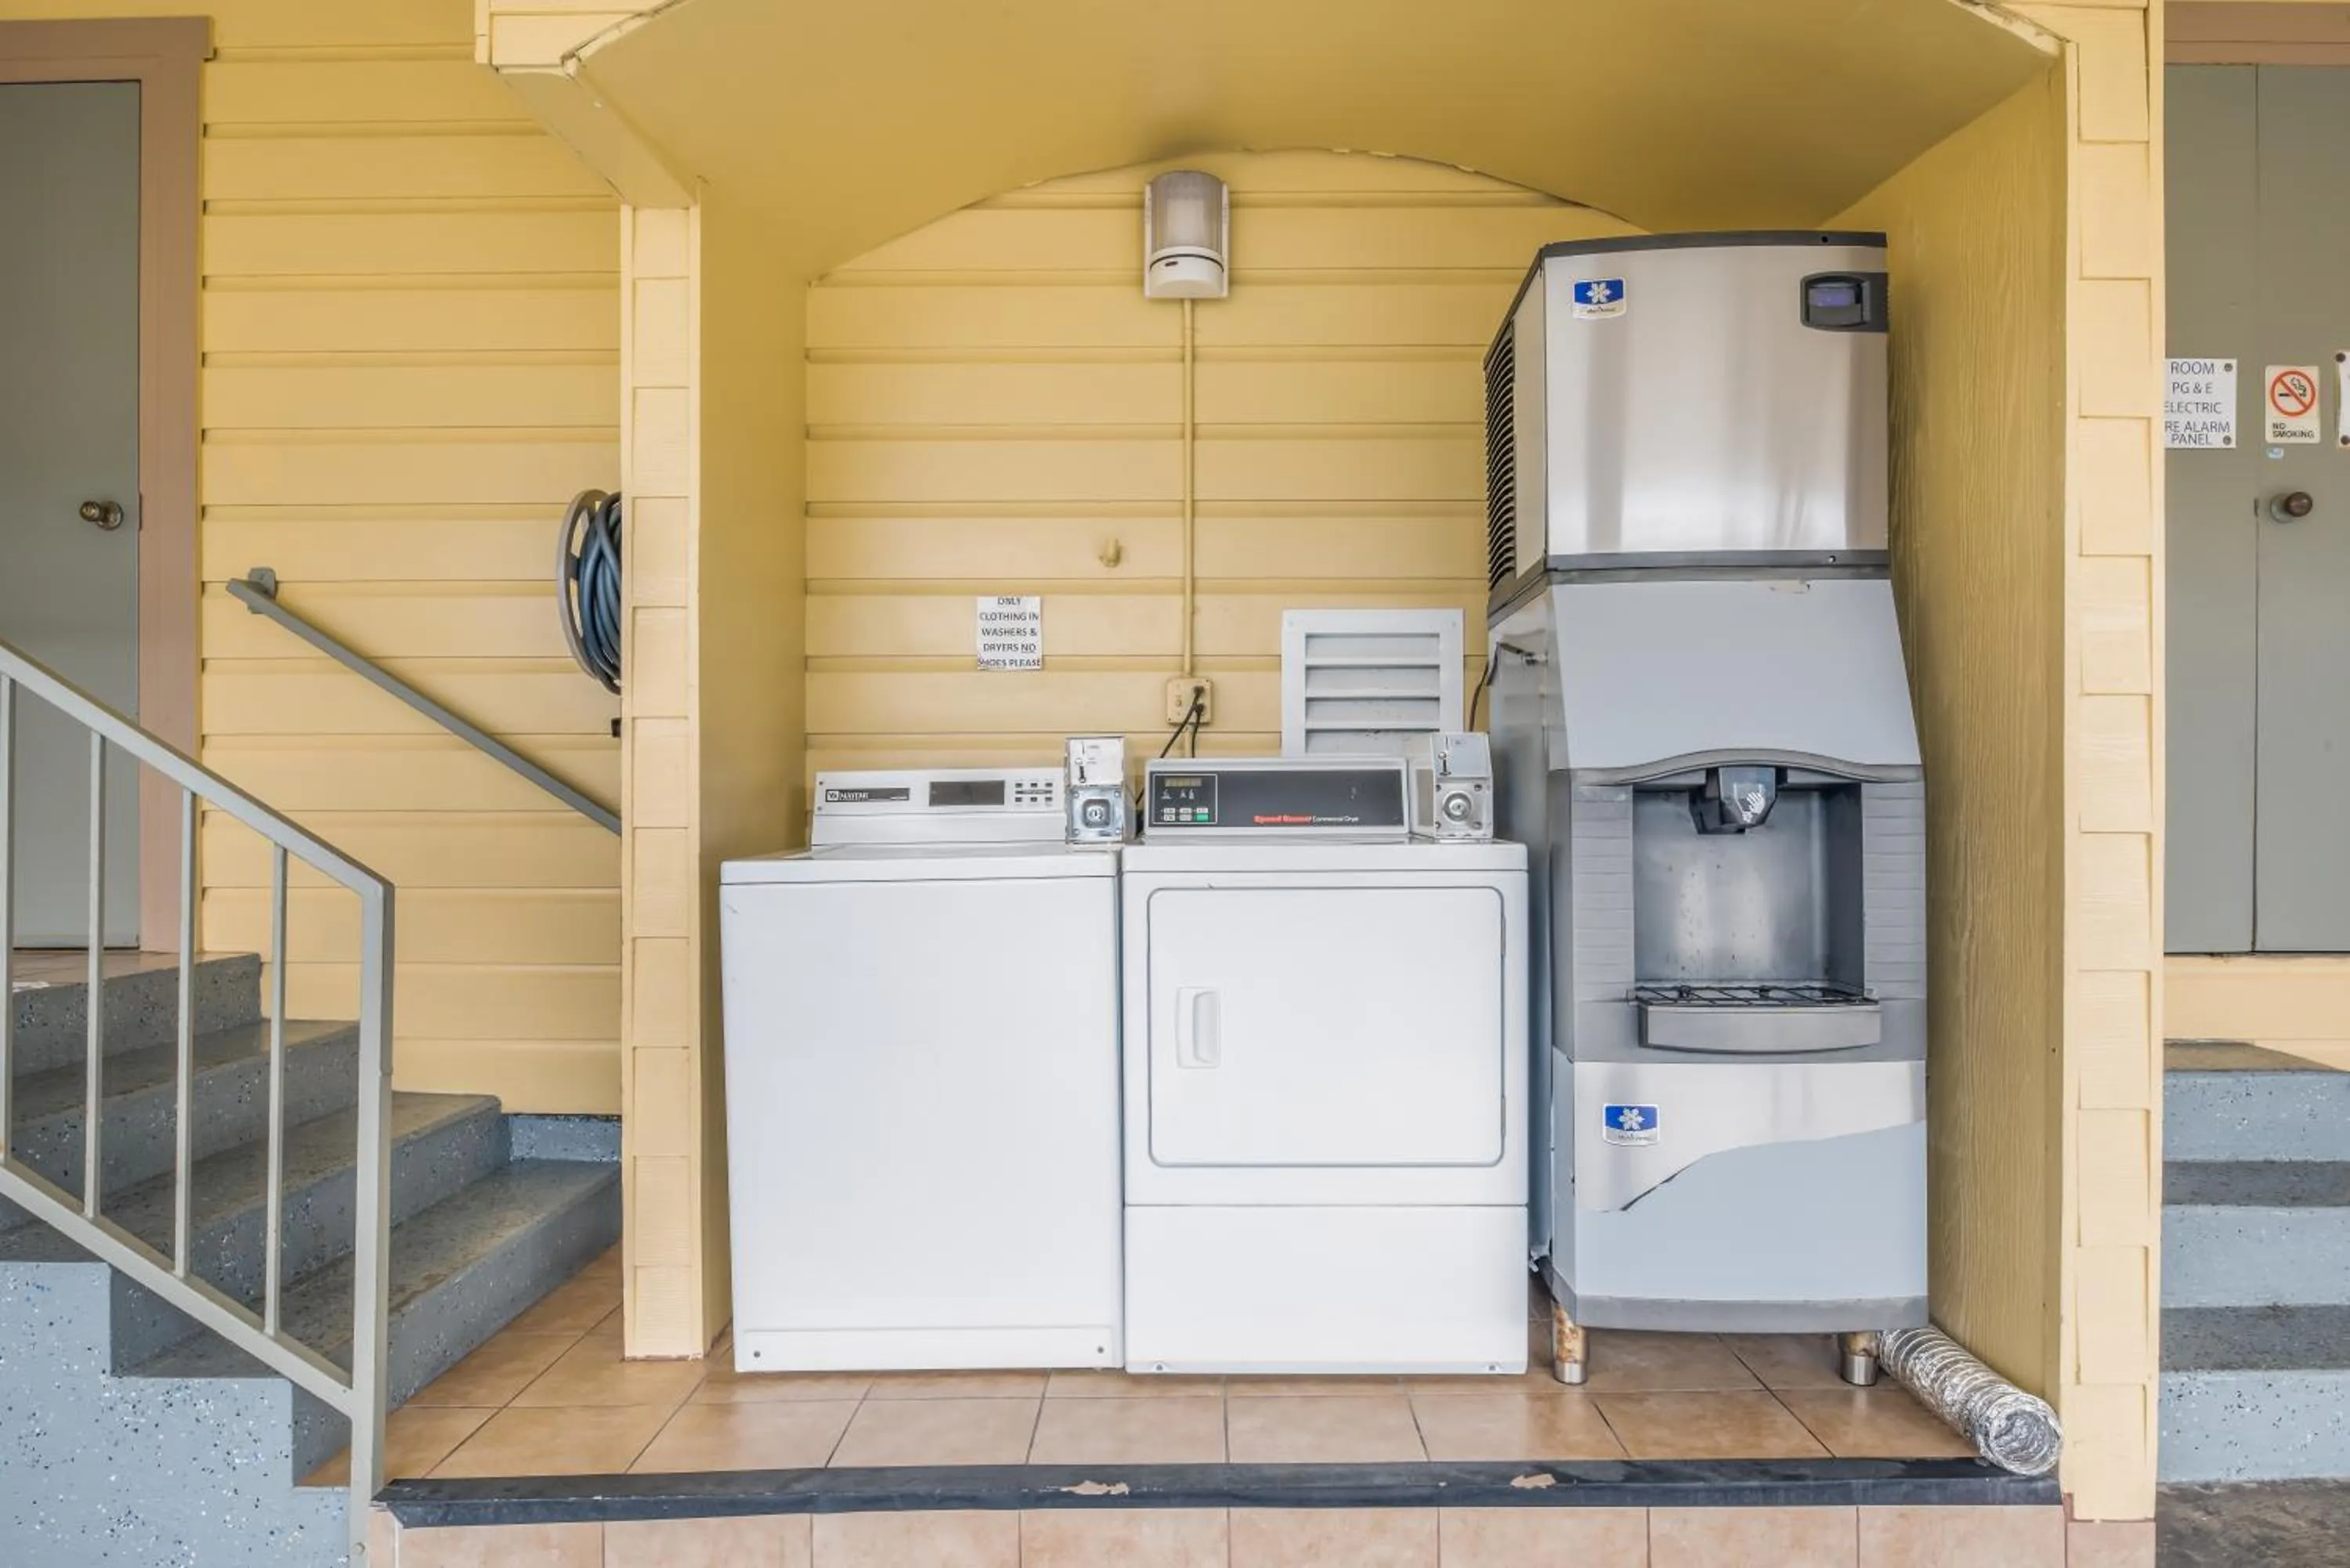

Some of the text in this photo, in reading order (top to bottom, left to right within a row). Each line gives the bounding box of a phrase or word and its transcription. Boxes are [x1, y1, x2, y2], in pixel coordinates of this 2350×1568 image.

[2171, 361, 2214, 374] ROOM
[2172, 381, 2213, 394] PG & E
[2164, 421, 2230, 433] RE ALARM
[2171, 433, 2212, 446] PANEL
[2272, 430, 2315, 439] SMOKING
[979, 612, 1039, 621] CLOTHING IN
[982, 628, 1027, 637] WASHERS
[983, 643, 1036, 653] DRYERS NO
